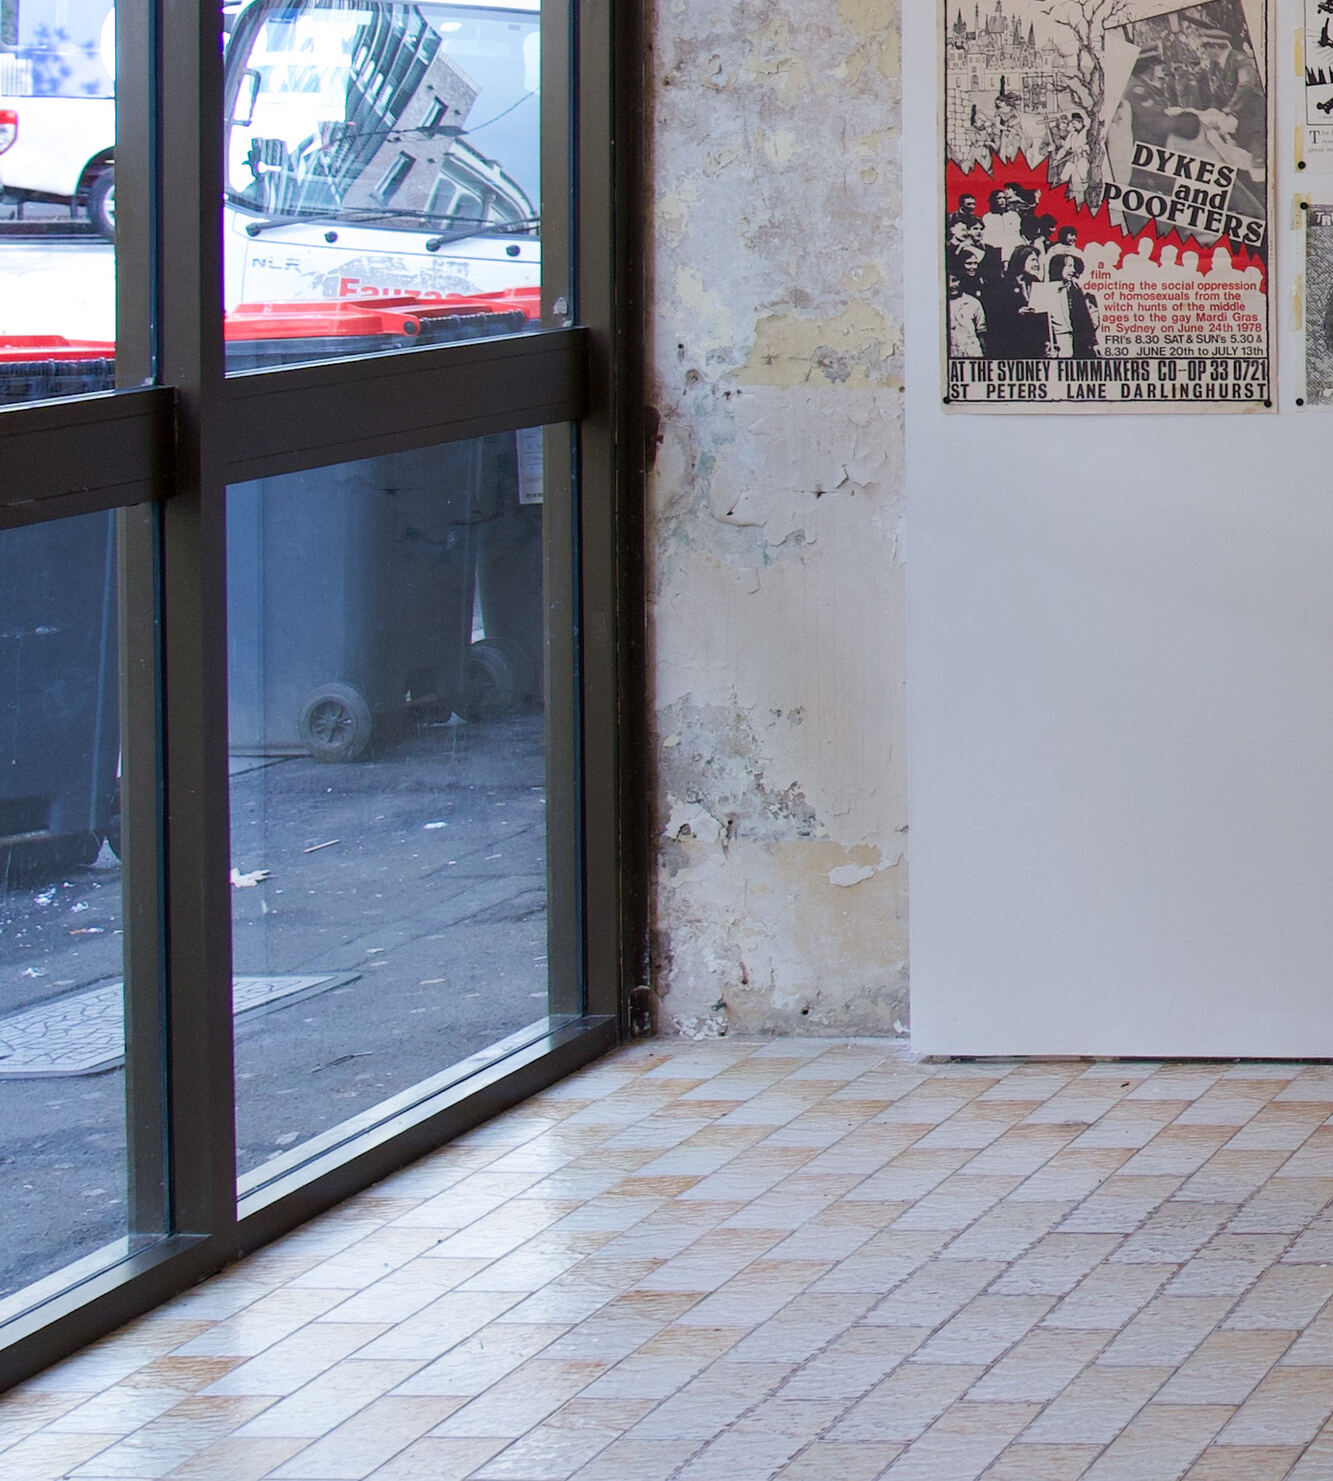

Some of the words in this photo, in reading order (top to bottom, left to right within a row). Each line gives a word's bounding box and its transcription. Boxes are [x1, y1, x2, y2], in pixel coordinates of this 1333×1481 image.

[1132, 143, 1234, 188] DYKES
[1174, 183, 1227, 211] and
[1102, 182, 1265, 245] POOFTERS
[1084, 281, 1136, 292] depicting
[1140, 281, 1157, 290] the
[1161, 281, 1195, 290] social
[1197, 281, 1257, 292] oppression
[951, 360, 968, 382] AT
[971, 360, 995, 382] THE
[998, 360, 1050, 382] SYDNEY
[1057, 360, 1150, 382] FILMMAKERS
[1157, 360, 1207, 382] CO-OP
[1211, 360, 1229, 382] 33
[1233, 360, 1266, 382] 0721
